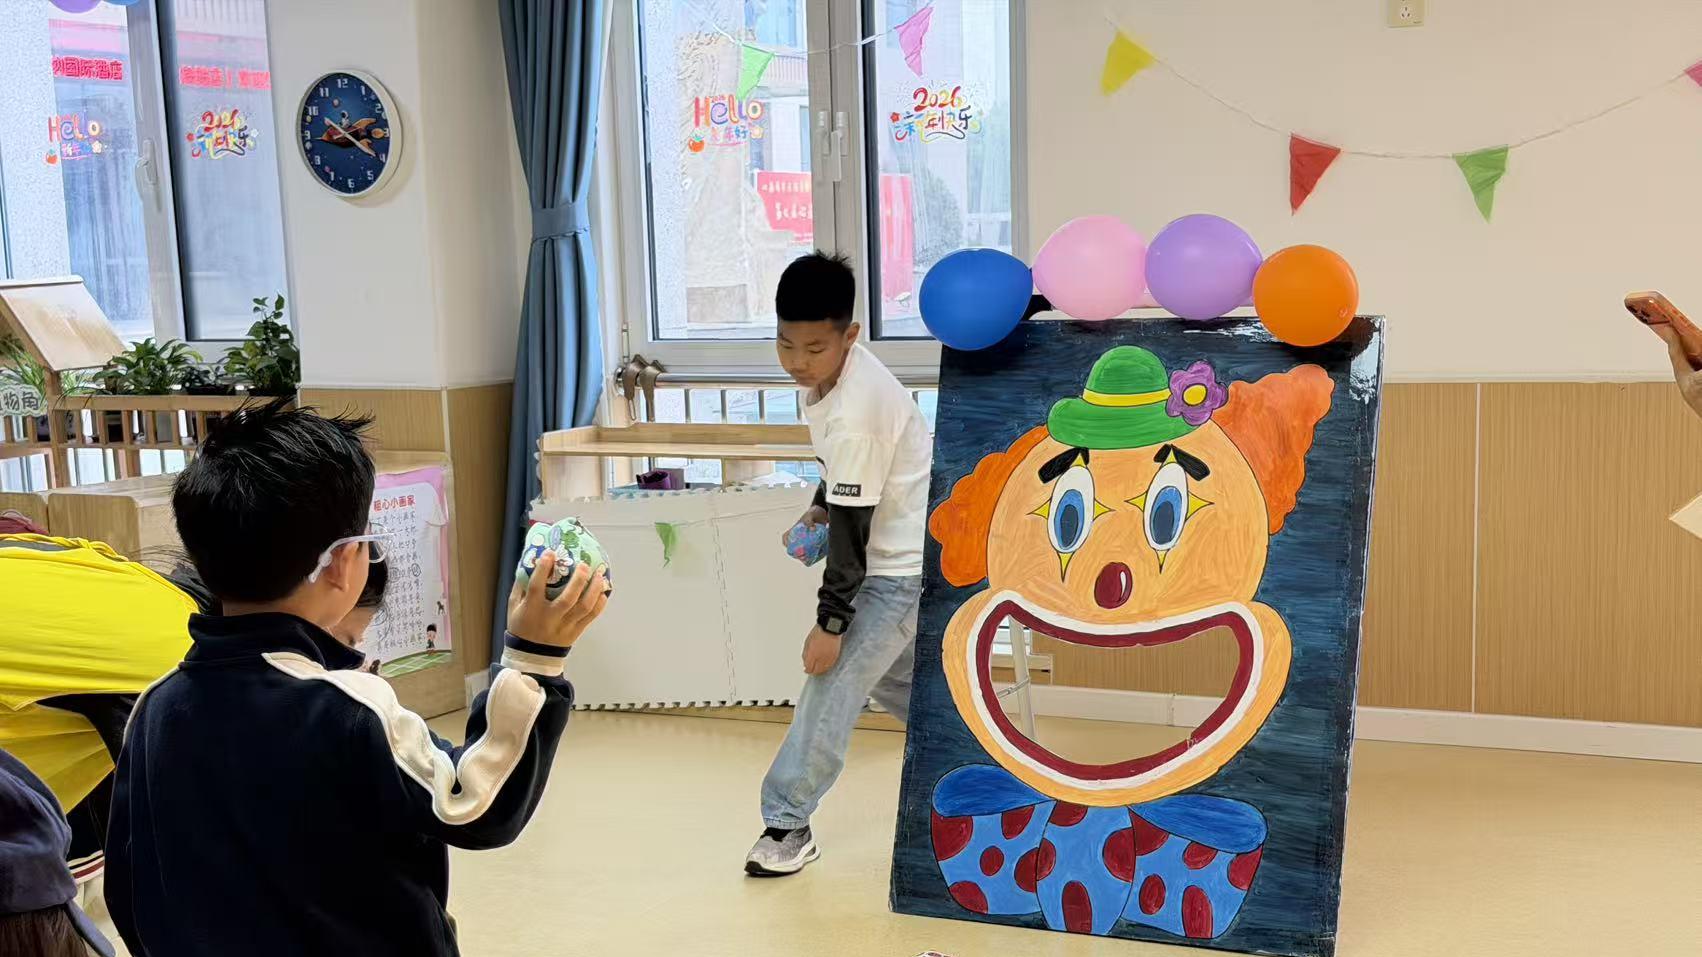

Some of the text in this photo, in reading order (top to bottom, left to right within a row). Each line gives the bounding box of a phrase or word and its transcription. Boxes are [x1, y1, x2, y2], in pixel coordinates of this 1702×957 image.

[337, 78, 348, 88] 12
[319, 87, 329, 97] 11
[360, 85, 366, 95] 1
[913, 85, 962, 112] 2026
[308, 106, 319, 116] 10
[375, 103, 383, 113] 2
[694, 94, 764, 128] Hello
[48, 114, 101, 143] Hello
[304, 130, 311, 140] 9
[379, 153, 386, 163] 4
[367, 170, 374, 180] 5
[347, 178, 355, 188] 6
[0, 391, 39, 411] 物角
